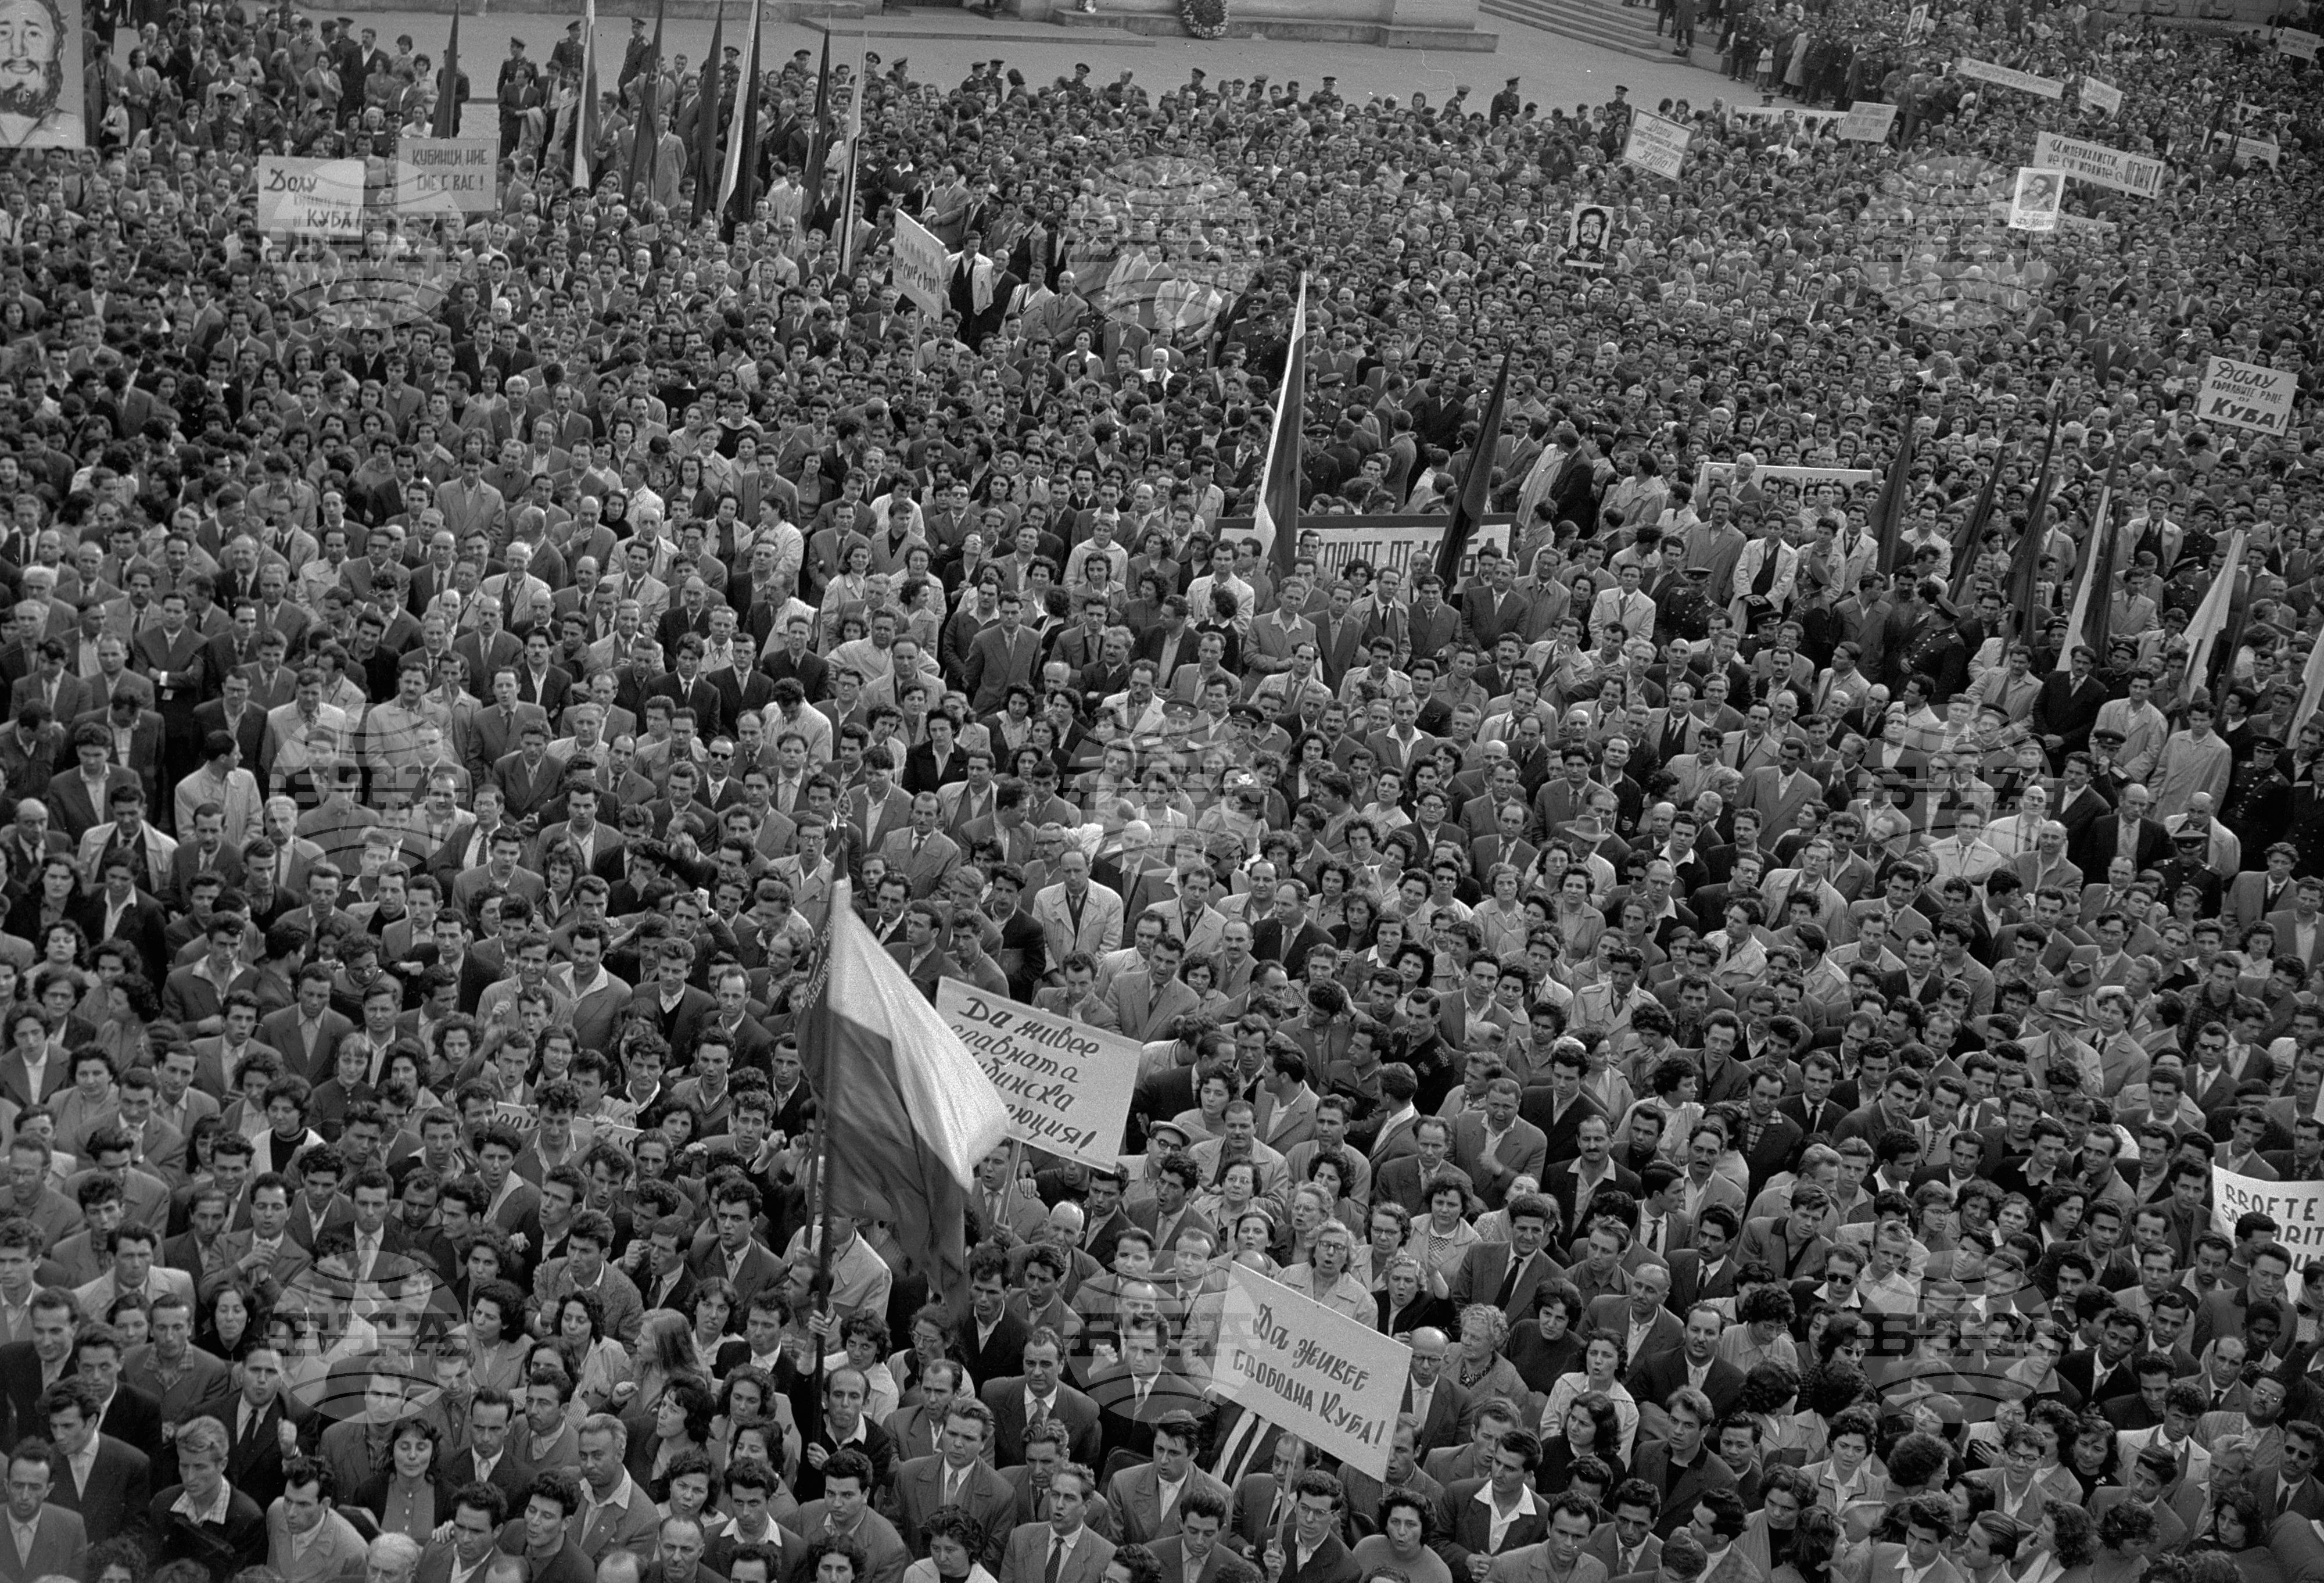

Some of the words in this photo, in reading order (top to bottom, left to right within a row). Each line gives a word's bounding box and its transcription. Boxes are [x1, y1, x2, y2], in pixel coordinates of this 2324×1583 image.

[467, 151, 488, 166] НИЕ
[442, 174, 449, 191] С
[307, 207, 362, 230] КУБА!
[2210, 397, 2286, 429] КУБА!
[2259, 390, 2283, 404] РЪЦЕ
[808, 957, 833, 1009] СЪЕДИНЯВ
[958, 997, 1013, 1029] Да
[1014, 1020, 1100, 1058] живее
[972, 1051, 1076, 1112] бинска
[2225, 1183, 2319, 1222] RROFTE
[1253, 1303, 1289, 1350] Да
